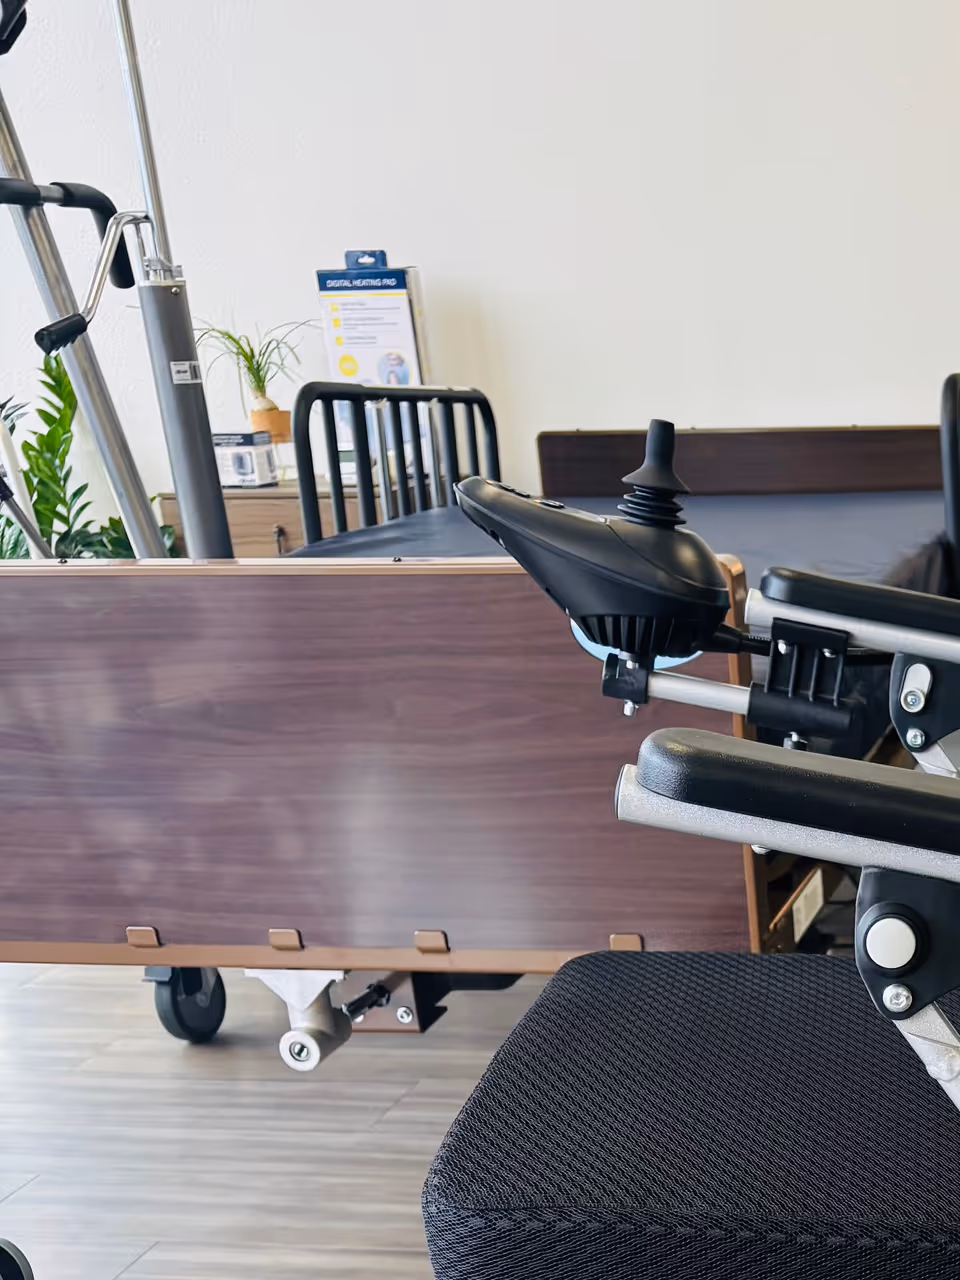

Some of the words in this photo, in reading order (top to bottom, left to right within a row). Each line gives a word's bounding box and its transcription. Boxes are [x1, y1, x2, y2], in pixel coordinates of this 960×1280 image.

[326, 279, 352, 288] DIGITAL
[352, 278, 382, 287] HEATING
[382, 278, 397, 287] PAD
